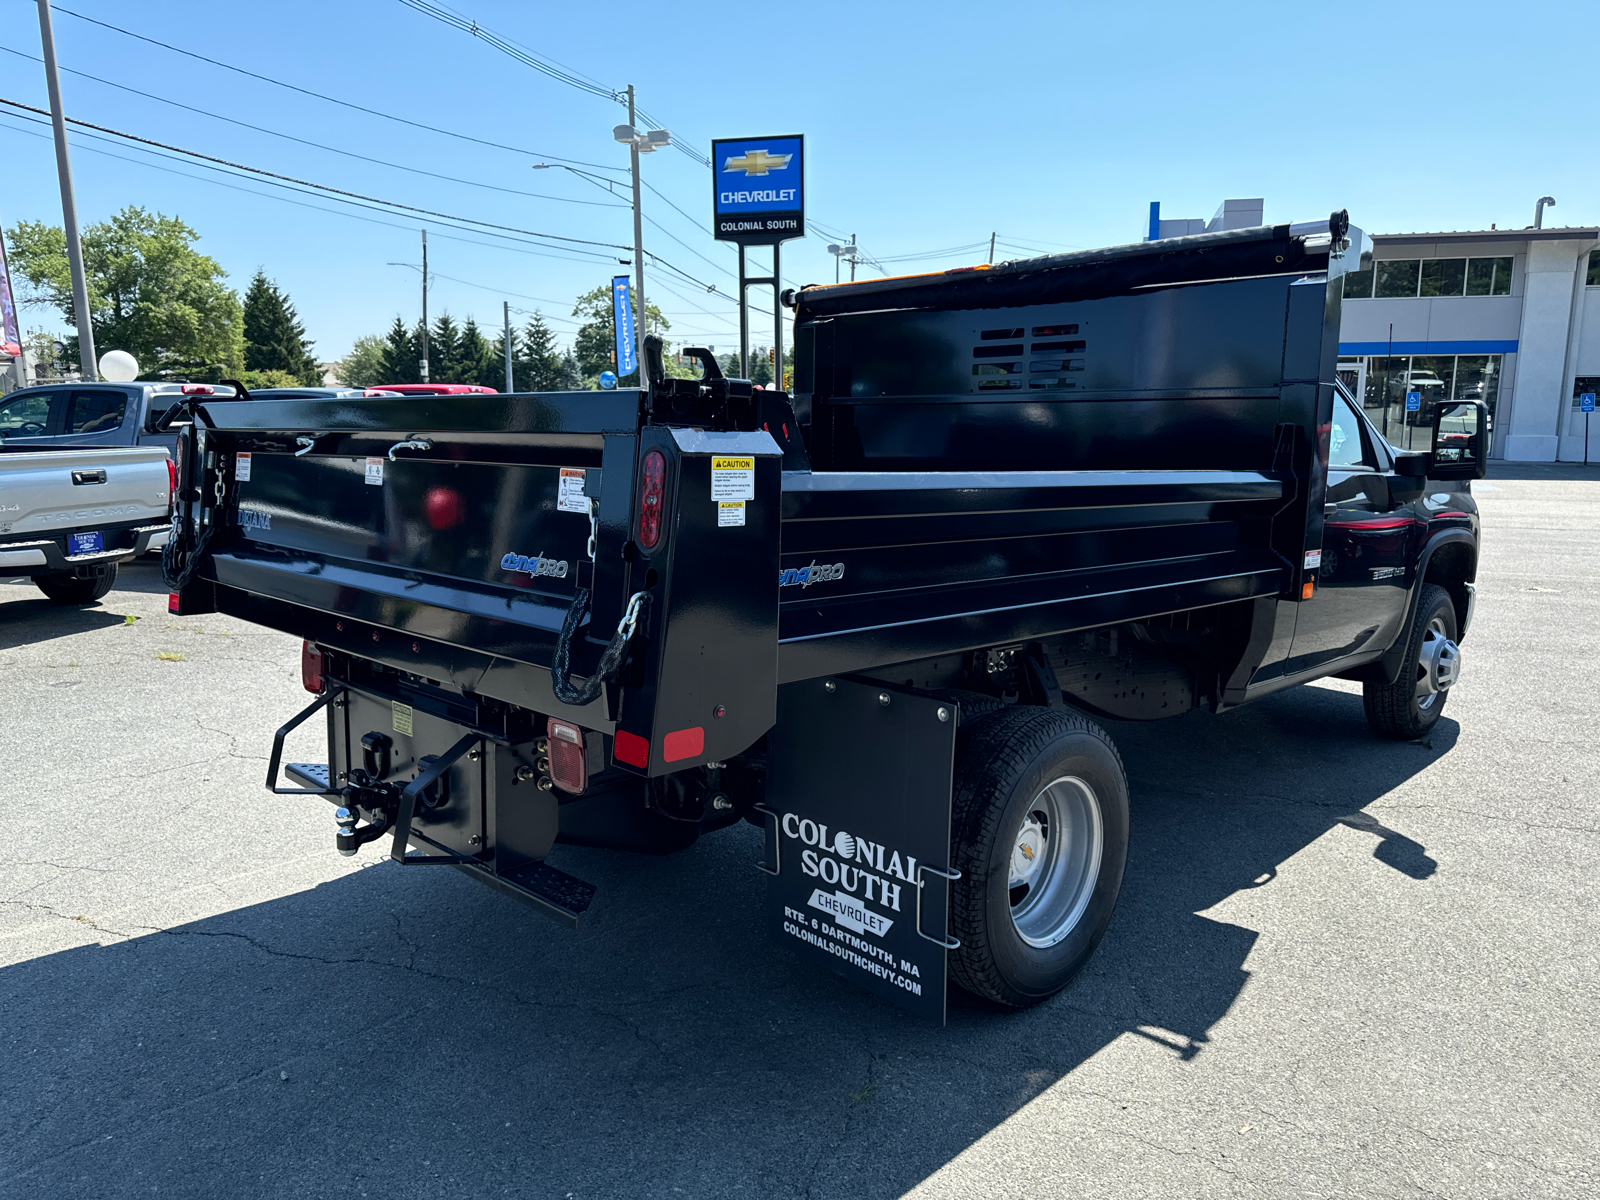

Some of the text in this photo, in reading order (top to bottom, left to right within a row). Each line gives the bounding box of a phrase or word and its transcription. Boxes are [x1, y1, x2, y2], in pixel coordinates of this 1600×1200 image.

[721, 189, 796, 203] CHEVROLET
[721, 220, 797, 231] COLONIAL SOUTH
[36, 505, 139, 523] TACOMA
[237, 509, 271, 531] DEJANA
[782, 812, 925, 888] COLONIAL
[801, 849, 901, 912] SOUTH
[818, 893, 884, 931] CHEVROLET
[783, 921, 922, 996] COLONIALSOUTHCHEVY.COM
[784, 906, 920, 978] RTE. 6 DARTMOUTH, MA
